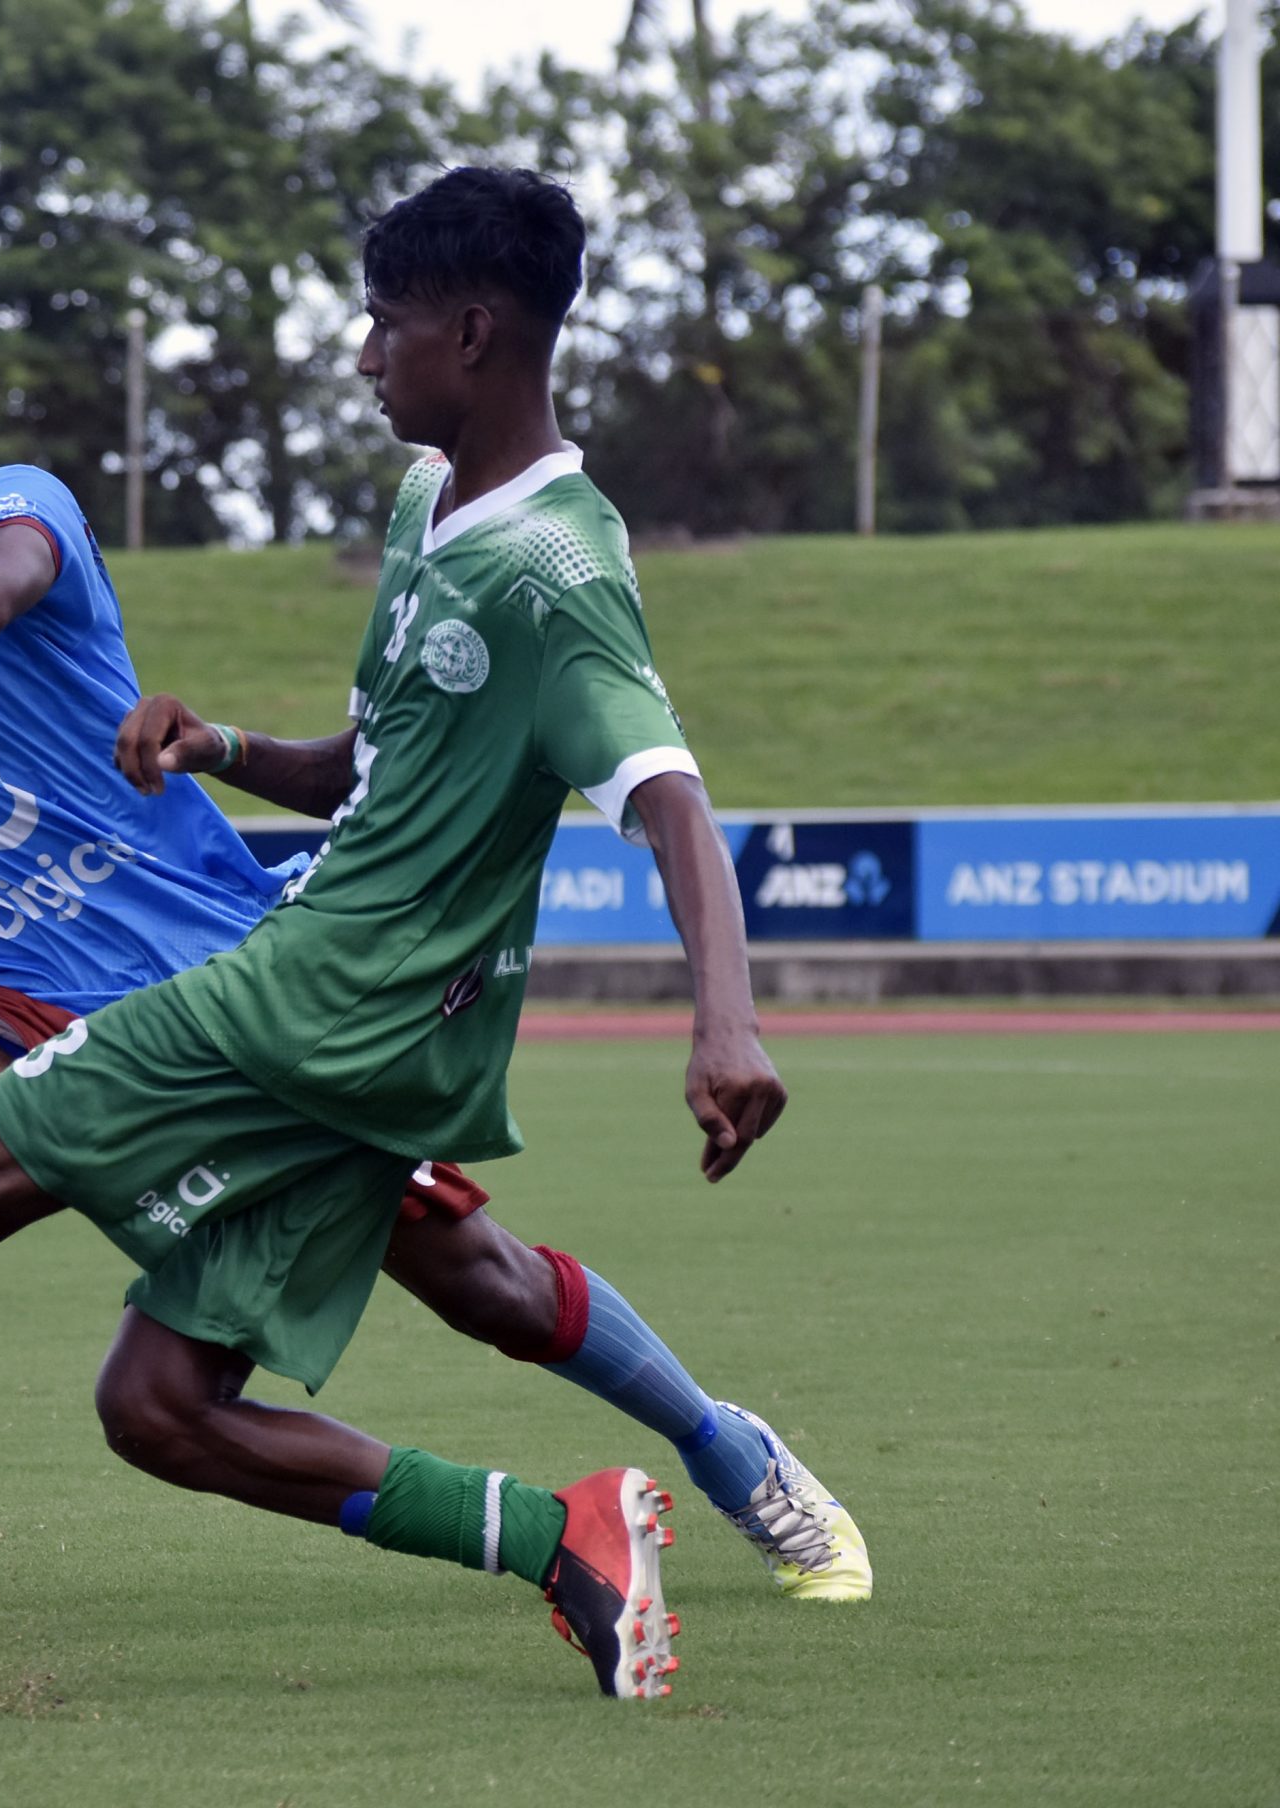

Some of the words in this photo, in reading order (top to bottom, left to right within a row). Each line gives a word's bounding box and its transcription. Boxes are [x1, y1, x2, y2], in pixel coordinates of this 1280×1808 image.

[755, 863, 847, 907] ANZ
[947, 863, 1044, 906] ANZ
[1049, 859, 1250, 906] STADIUM
[135, 1190, 192, 1238] Digic
